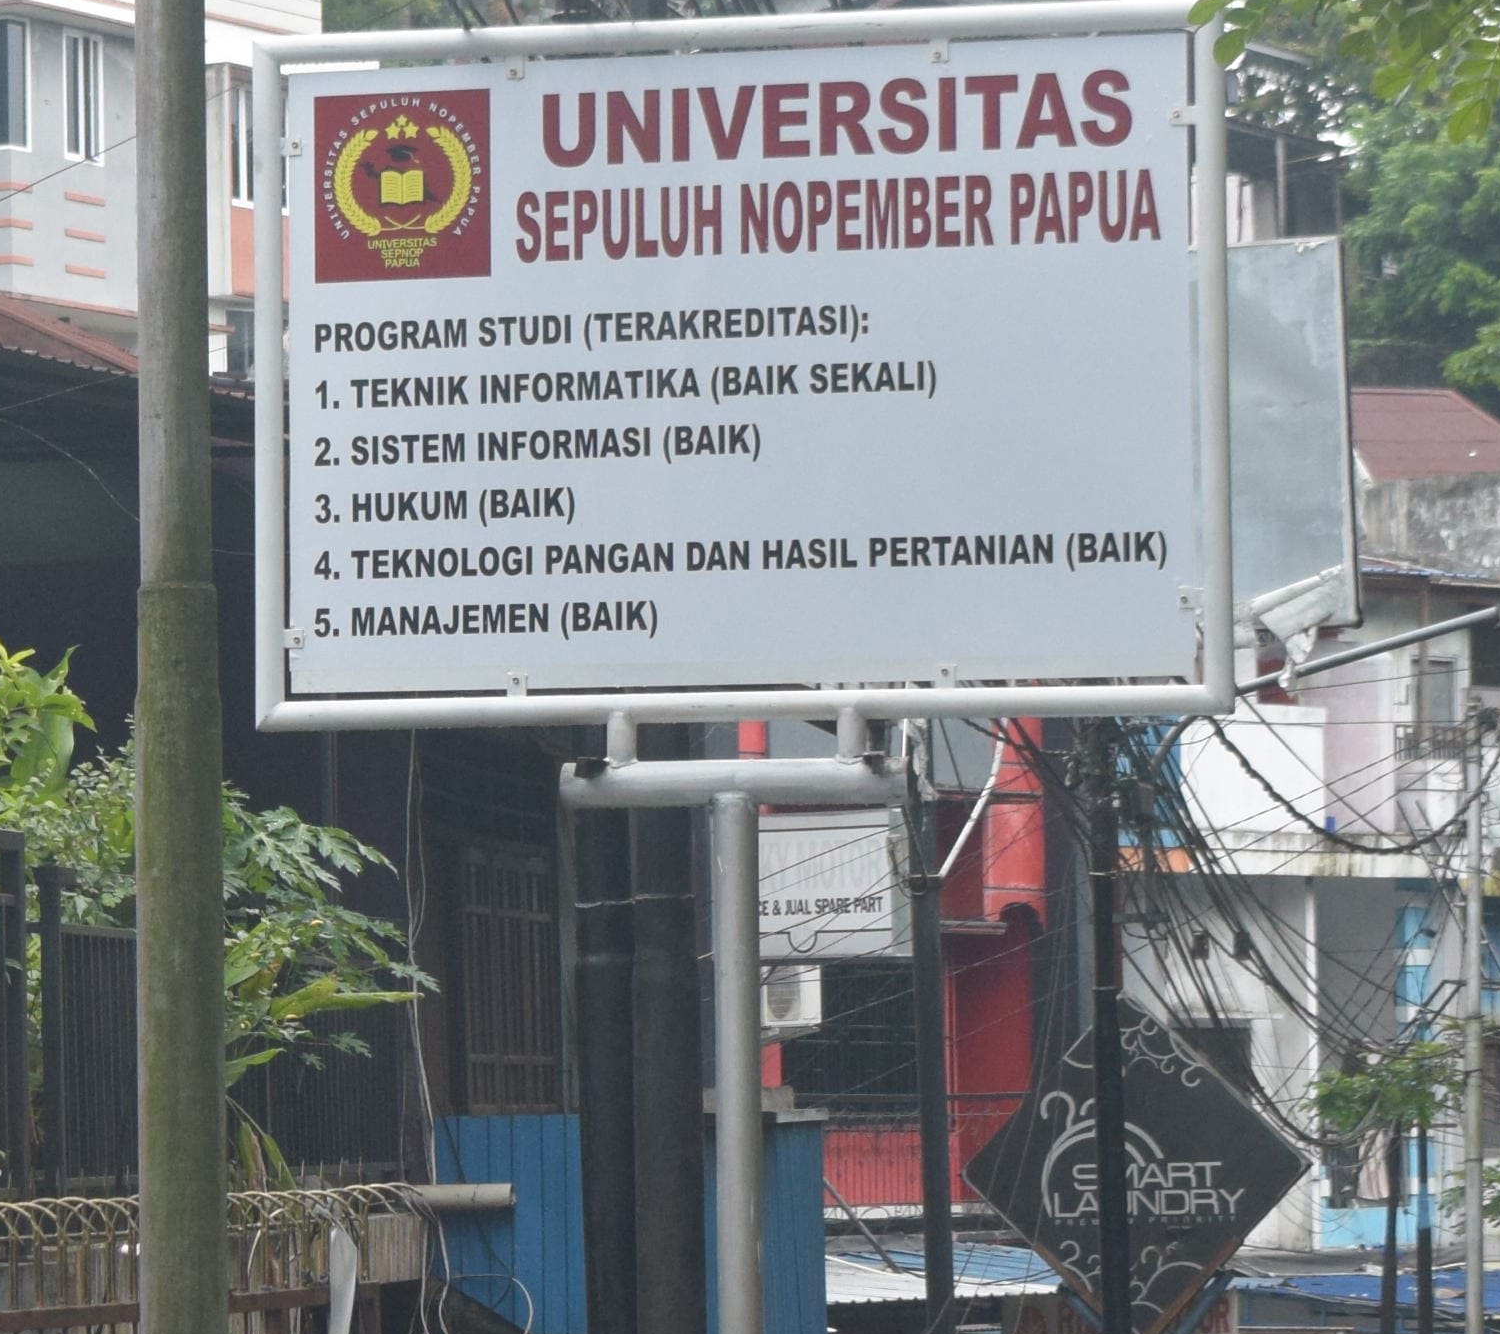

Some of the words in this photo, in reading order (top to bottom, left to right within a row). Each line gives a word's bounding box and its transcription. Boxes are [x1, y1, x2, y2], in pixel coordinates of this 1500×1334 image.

[351, 97, 420, 127] SEPULUH
[543, 70, 1132, 168] UNIVERSITAS
[428, 102, 482, 176] NOPEMBER
[324, 130, 350, 240] UNIVERSITAS
[452, 186, 481, 237] PAPUA
[516, 185, 722, 263] SEPULUH
[741, 175, 993, 254] NOPEMBER
[1011, 169, 1160, 245] PAPUA
[367, 237, 437, 250] UNIVERSITAS
[381, 247, 424, 260] SEPNOP
[385, 257, 420, 268] PAPUA
[315, 319, 467, 353] PROGRAM
[479, 315, 572, 348] STUDI
[584, 305, 869, 351] (TERAKREDITASI):
[316, 380, 340, 410] 1.
[351, 376, 469, 409] TEKNIK
[481, 368, 700, 405] INFORMATIKA
[711, 365, 799, 405] (BAIK
[810, 361, 937, 400] SEKALI)
[315, 437, 340, 467] 2.
[351, 433, 466, 466] SISTEM
[478, 427, 651, 462] INFORMASI
[663, 424, 761, 464] (BAIK)
[315, 494, 340, 524] 3.
[352, 491, 468, 523] HUKUM
[479, 487, 576, 527] (BAIK)
[314, 551, 340, 581] 4.
[351, 546, 533, 580] TEKNOLOGI
[546, 543, 674, 575] PANGAN
[687, 541, 750, 572] DAN
[763, 539, 857, 570] HASIL
[870, 534, 1054, 568] PERTANIAN
[1066, 531, 1167, 571] (BAIK)
[315, 608, 340, 638] 5.
[351, 603, 549, 637] MANAJEMEN
[560, 601, 658, 641] (BAIK)
[785, 898, 811, 916] JUAL
[815, 897, 851, 915] SPARE
[853, 895, 883, 914] PART
[1054, 1188, 1245, 1218] LANDRY
